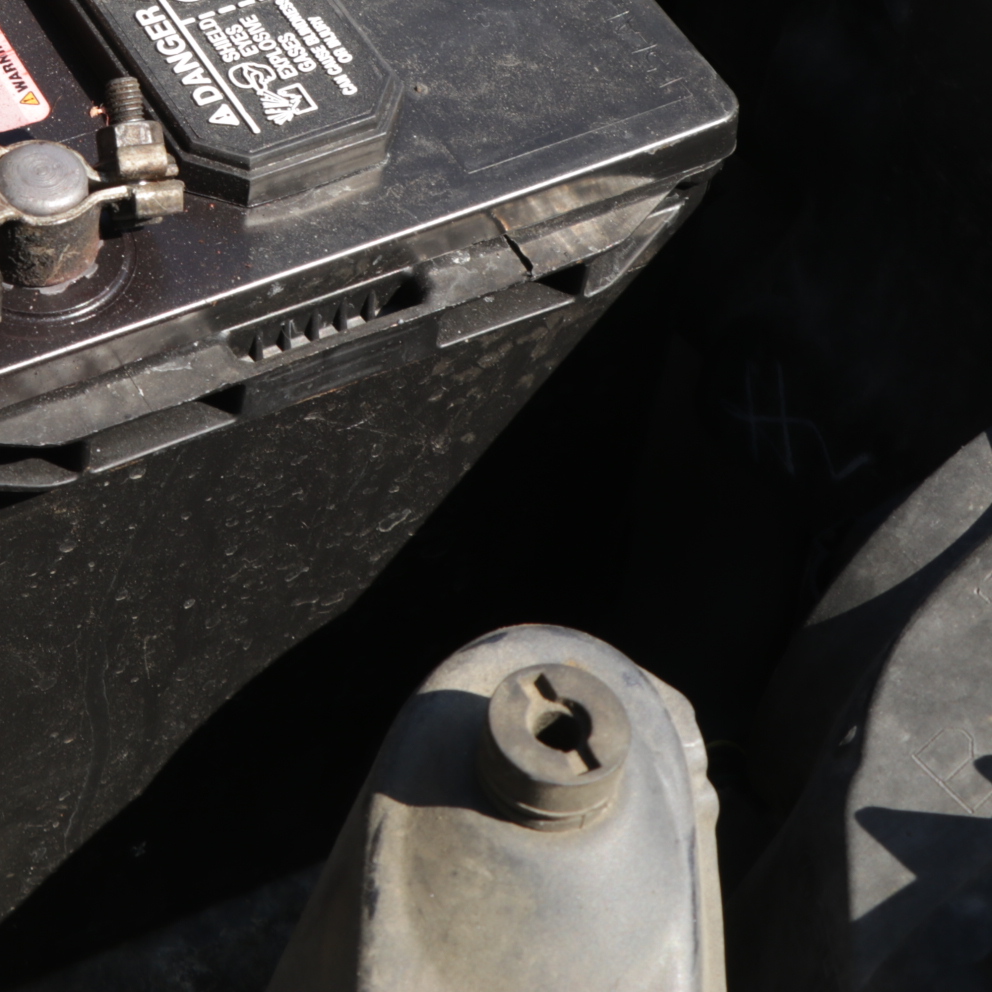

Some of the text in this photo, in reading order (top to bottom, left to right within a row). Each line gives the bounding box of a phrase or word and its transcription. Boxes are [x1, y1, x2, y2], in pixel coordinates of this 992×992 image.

[135, 4, 224, 106] DANGER
[194, 17, 241, 63] SHIELD
[221, 23, 260, 57] EYES
[238, 13, 299, 80] EXPLOSIVE
[277, 31, 317, 72] GASES
[307, 15, 354, 64] OR INJURY
[309, 43, 343, 76] CAUSE
[332, 73, 358, 96] CAN
